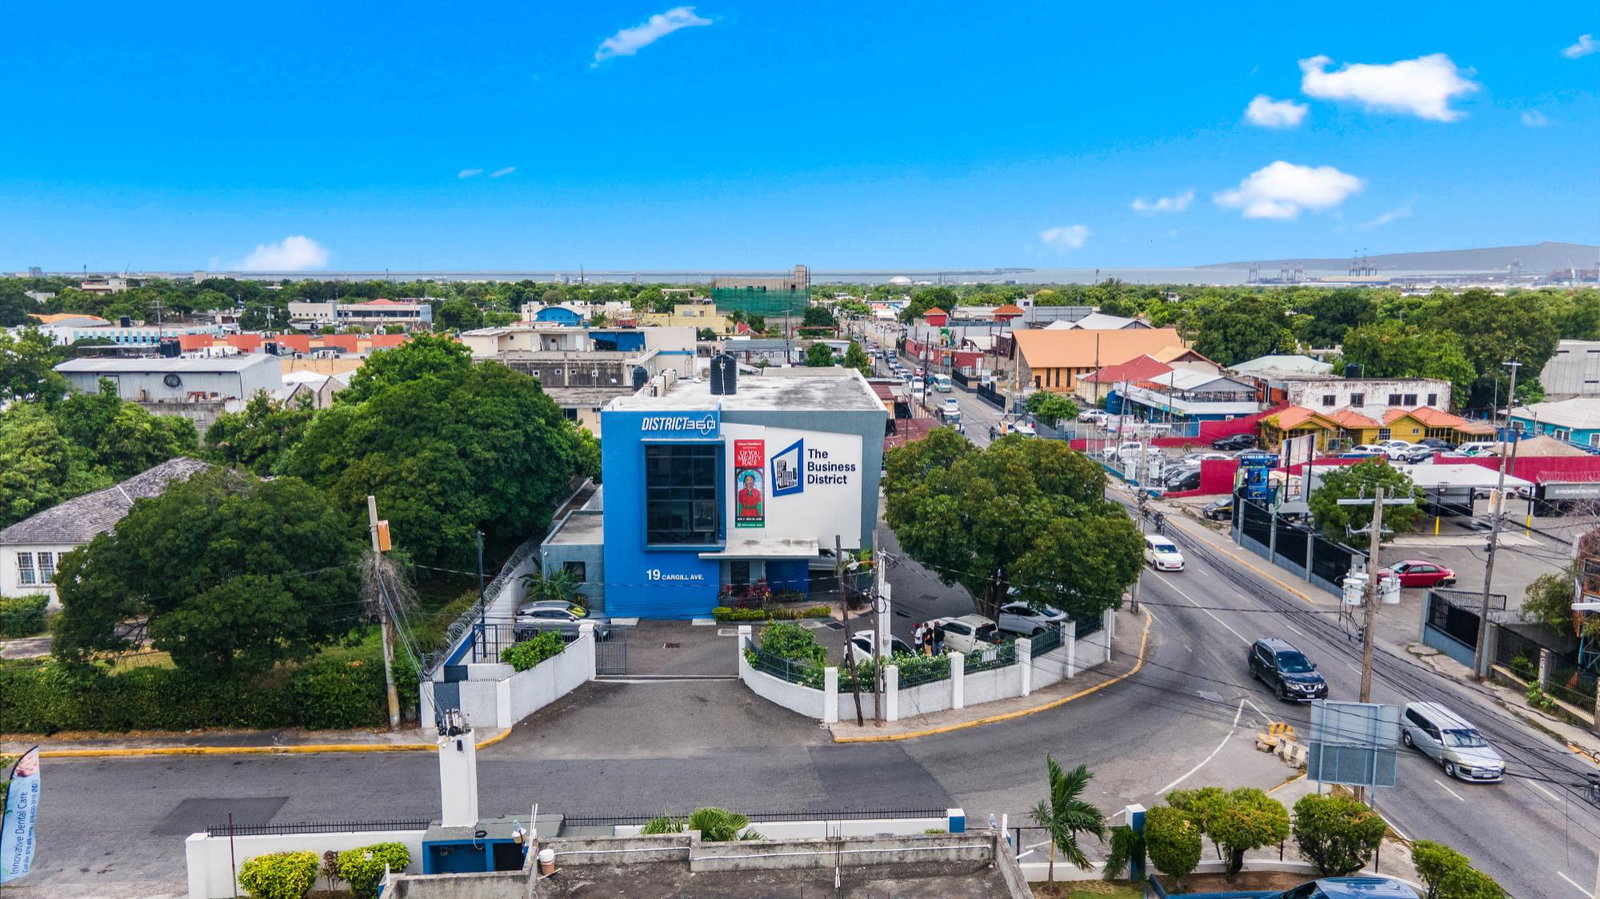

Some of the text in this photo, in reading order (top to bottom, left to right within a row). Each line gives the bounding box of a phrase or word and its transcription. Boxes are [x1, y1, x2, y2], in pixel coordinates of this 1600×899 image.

[807, 448, 828, 459] The
[807, 461, 856, 472] Business
[807, 474, 848, 485] District
[646, 569, 661, 581] 19
[10, 792, 29, 875] Innovative Dental Care
